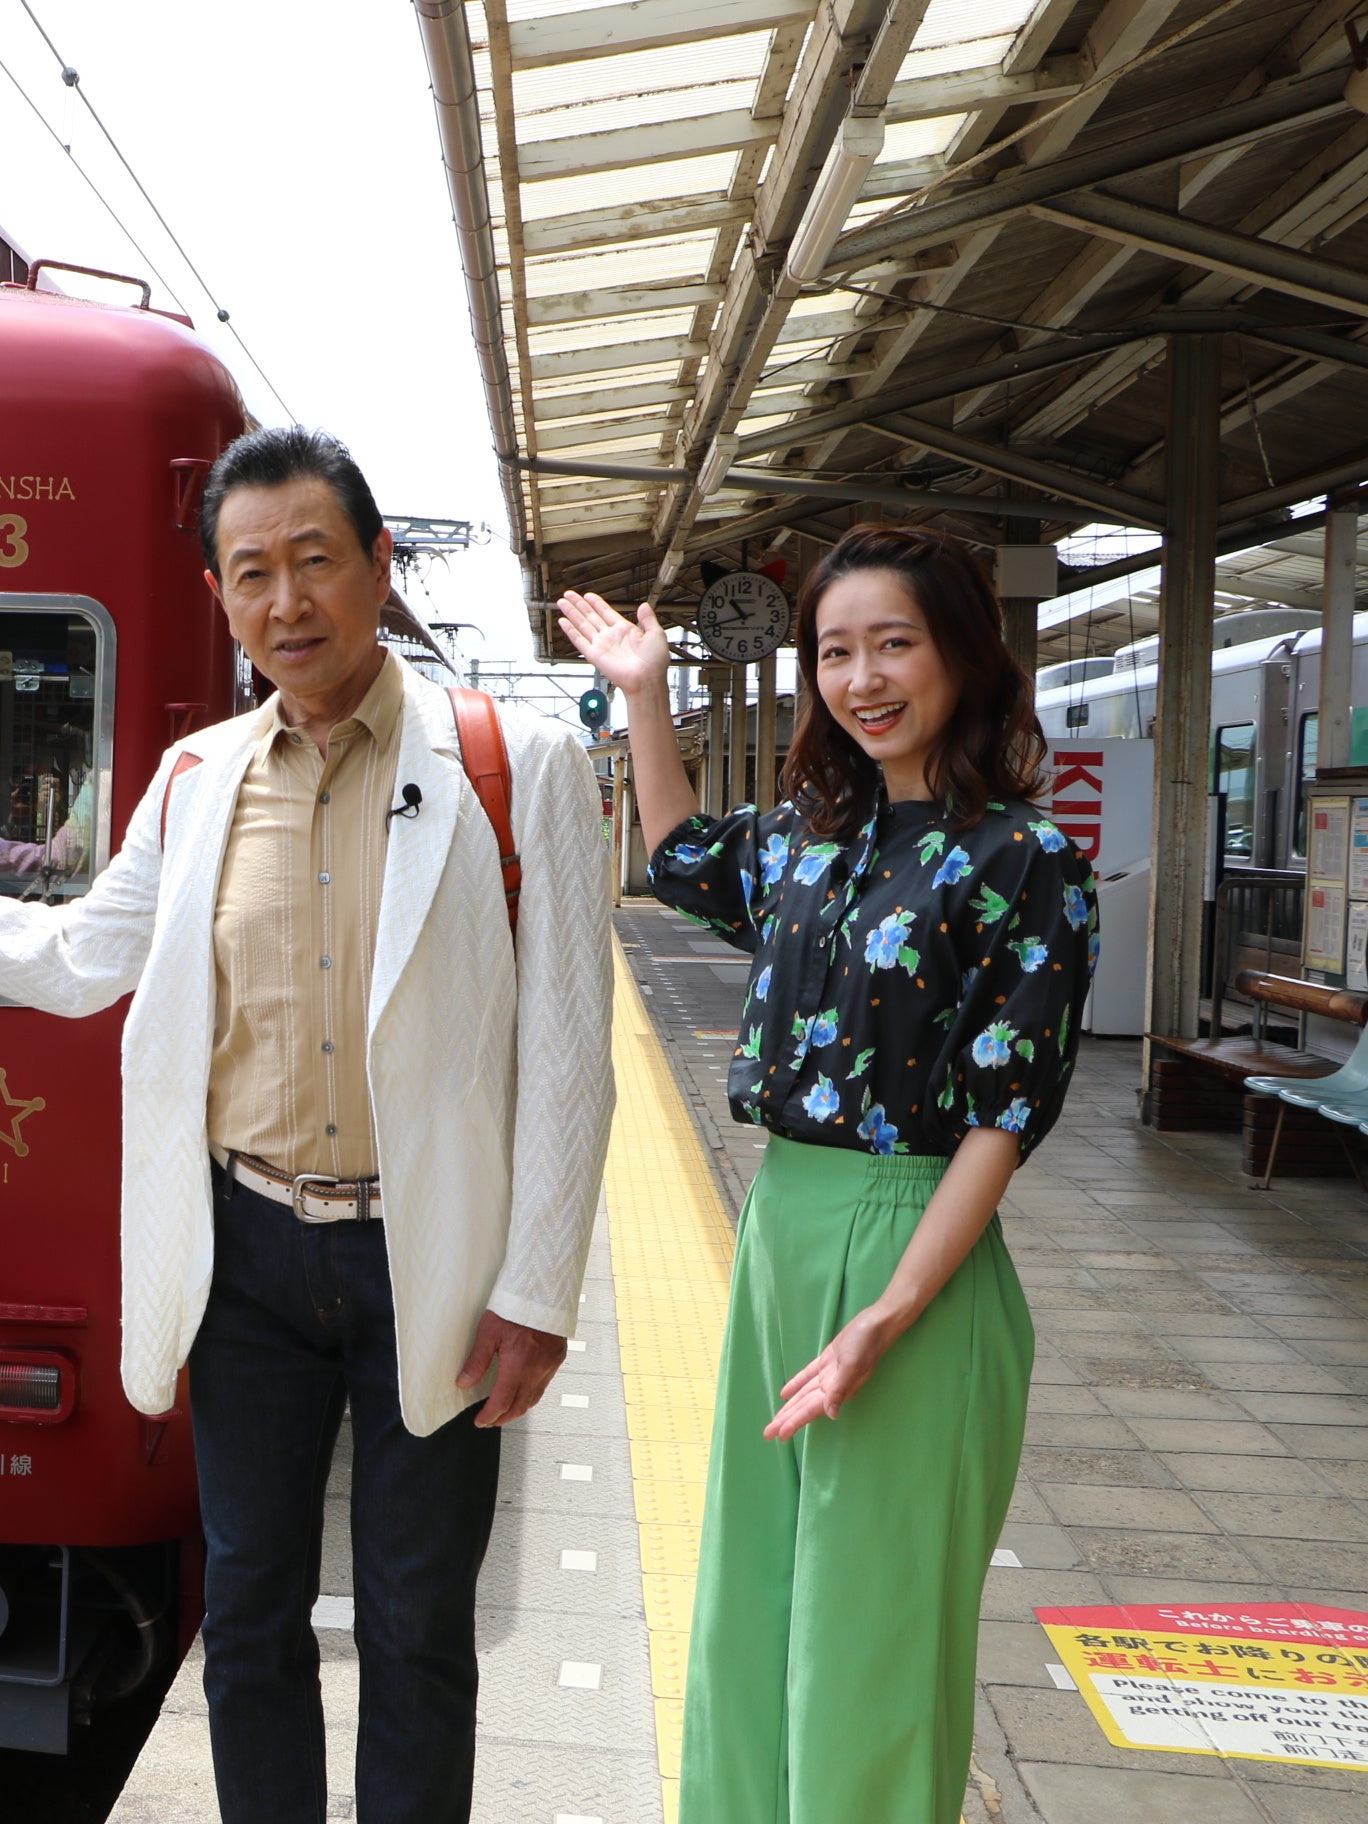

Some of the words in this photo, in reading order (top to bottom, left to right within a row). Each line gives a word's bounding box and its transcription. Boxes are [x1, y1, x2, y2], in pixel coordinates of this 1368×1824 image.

[738, 581, 752, 594] 12
[711, 596, 725, 609] 10
[766, 594, 777, 608] 2
[707, 610, 718, 624] 9
[770, 609, 781, 623] 3
[712, 624, 722, 638] 8
[764, 624, 776, 637] 4
[724, 636, 734, 650] 7
[737, 640, 748, 653] 6
[753, 636, 764, 649] 5
[1175, 1619, 1245, 1632] Before
[1248, 1625, 1349, 1641] boarding
[1112, 1679, 1200, 1696] Please
[1210, 1689, 1288, 1702] come
[1297, 1695, 1328, 1706] to
[1121, 1694, 1172, 1704] and
[1266, 1705, 1331, 1716] your
[1128, 1704, 1229, 1722] getting
[1232, 1712, 1270, 1723] off
[1276, 1717, 1324, 1729] our
